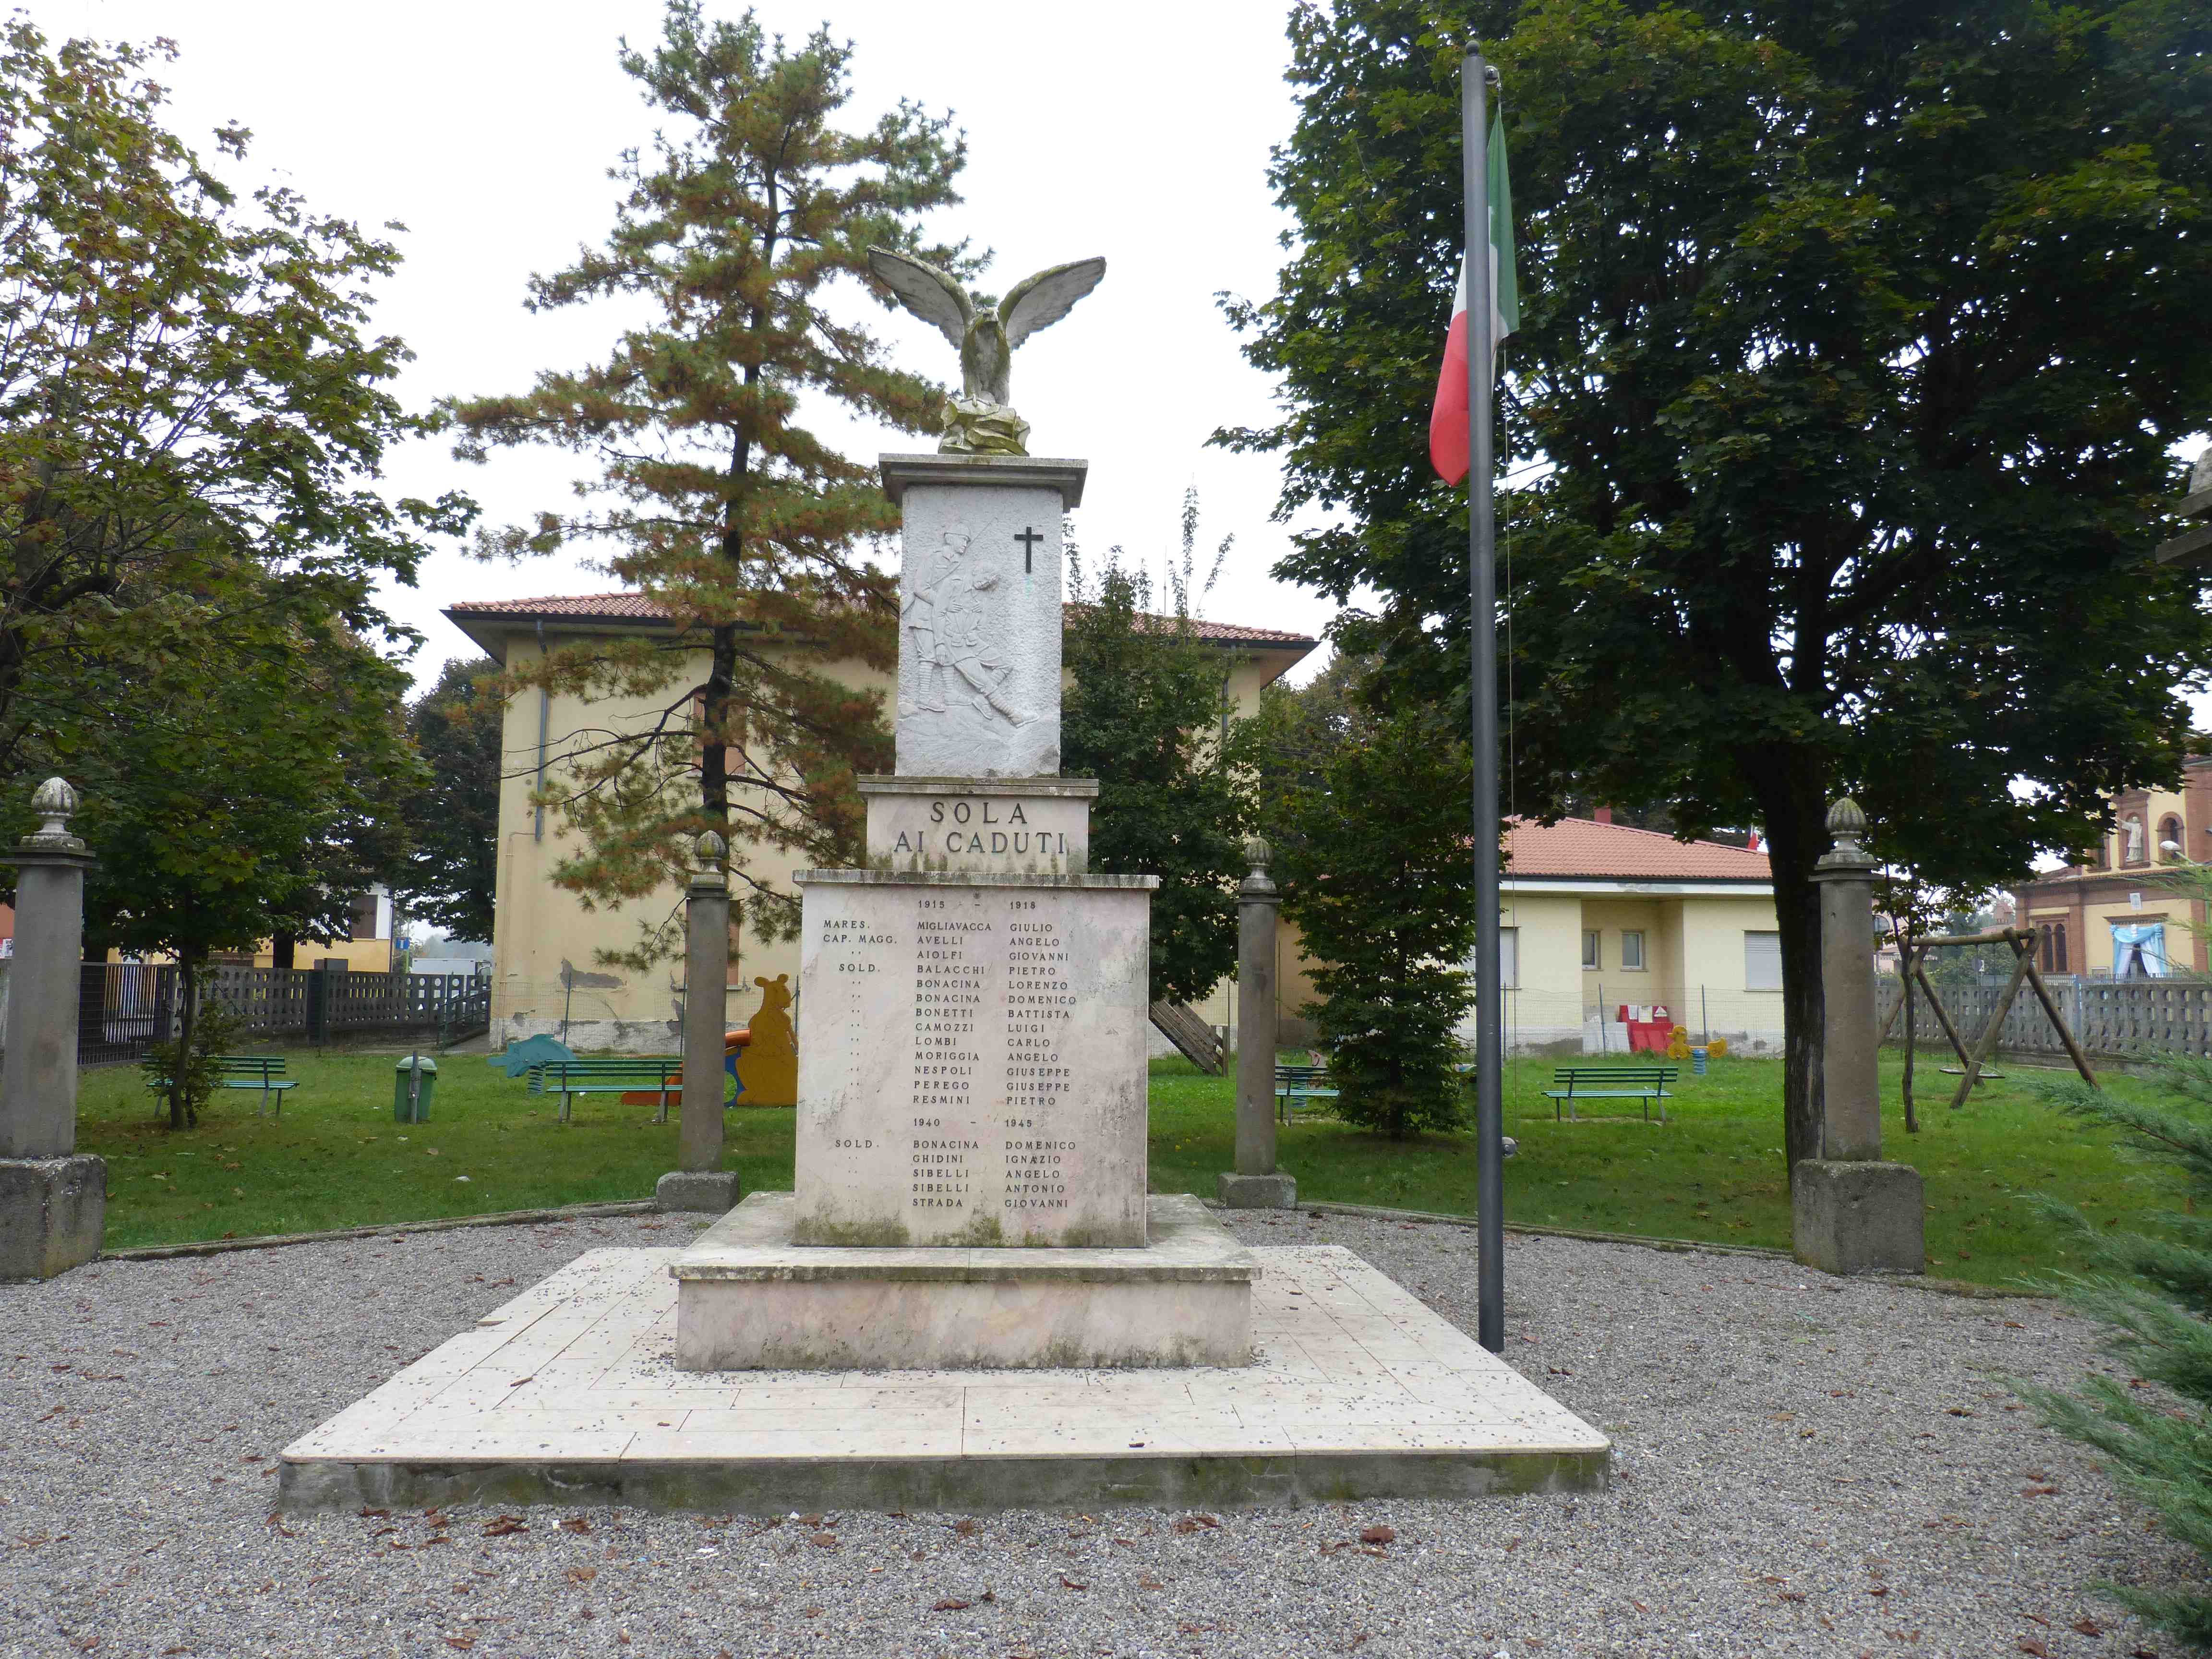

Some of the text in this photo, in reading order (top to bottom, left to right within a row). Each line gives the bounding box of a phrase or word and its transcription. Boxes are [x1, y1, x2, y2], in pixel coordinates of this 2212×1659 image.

[930, 801, 1027, 824] SOLA
[894, 831, 1064, 854] AI CADUTI
[824, 920, 1053, 932] MARES. MIGLIAVACCA GIULIO
[859, 935, 897, 944] MAGG.
[917, 936, 962, 945] AVELLI
[1010, 938, 1059, 946] ANGELO
[917, 951, 1068, 961] AIOLFI GIOVANNI
[839, 963, 1056, 975] SOLD. BALACCHI PIETRO
[917, 980, 1068, 990] BONACINA LORENZO
[916, 994, 1076, 1004] BONACINA DOMENICO
[916, 1009, 1070, 1019] BONETTI BATTISTA
[916, 1023, 1044, 1033] CAMOZZI LUIGI
[916, 1037, 1050, 1047] LOMBI CARLO
[915, 1052, 1058, 1061] MORIGGIA ANGELO
[915, 1066, 1070, 1076] NESPOLI GIUSEPPE
[914, 1081, 1070, 1091] PEREGO GIUSEPPE
[914, 1095, 1056, 1106] RESMINI PIETRO
[914, 1118, 940, 1127] 1940
[1005, 1119, 1032, 1128] 1945
[835, 1140, 1076, 1149] SOLD. BONACINA DOMENICO
[913, 1154, 1061, 1164] GHIDINI IGNAZIO
[913, 1169, 1060, 1178] SIBELLI ANGELO
[913, 1184, 1065, 1193] SIBELLI ANTONIO
[913, 1198, 1068, 1208] STRADA GIOVANNI
